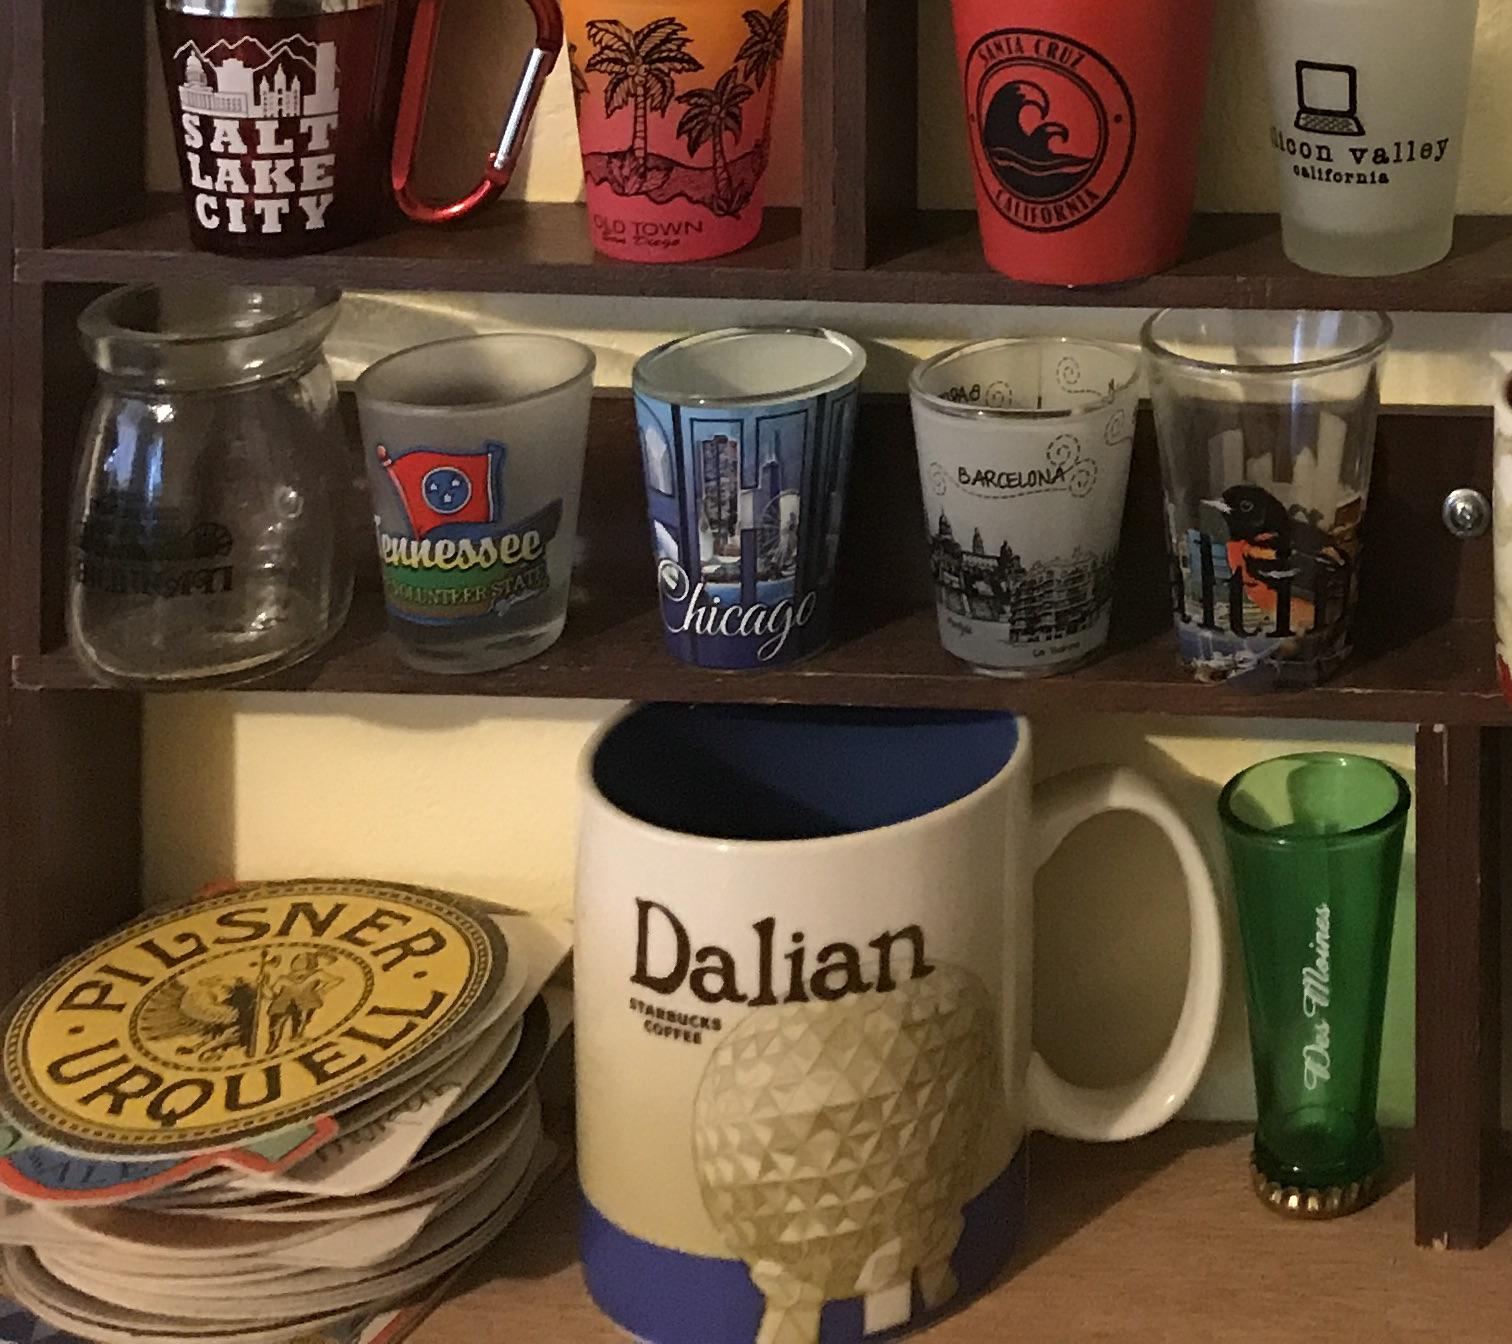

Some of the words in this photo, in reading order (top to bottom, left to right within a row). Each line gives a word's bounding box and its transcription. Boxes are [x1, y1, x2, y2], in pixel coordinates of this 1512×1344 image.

[976, 35, 1025, 68] SANTA
[1033, 36, 1086, 71] CRUZ
[182, 112, 339, 151] SALT
[1349, 137, 1450, 165] valley
[187, 152, 336, 194] LAKE
[1292, 164, 1390, 185] california
[196, 193, 334, 234] CITY
[995, 186, 1100, 225] CALIFORNIA
[592, 218, 627, 235] OLD
[632, 218, 704, 235] TOWN
[633, 235, 681, 250] Diego
[957, 465, 1067, 490] BARCELONA
[658, 558, 818, 662] Chicago
[56, 901, 447, 1017] PILSNER
[631, 897, 935, 1006] Dalian
[1301, 902, 1331, 1015] Moines
[628, 998, 723, 1031] STARBUCKS
[643, 1020, 704, 1045] COFFEE
[47, 988, 449, 1128] URQUELL
[1301, 1012, 1332, 1092] Des
